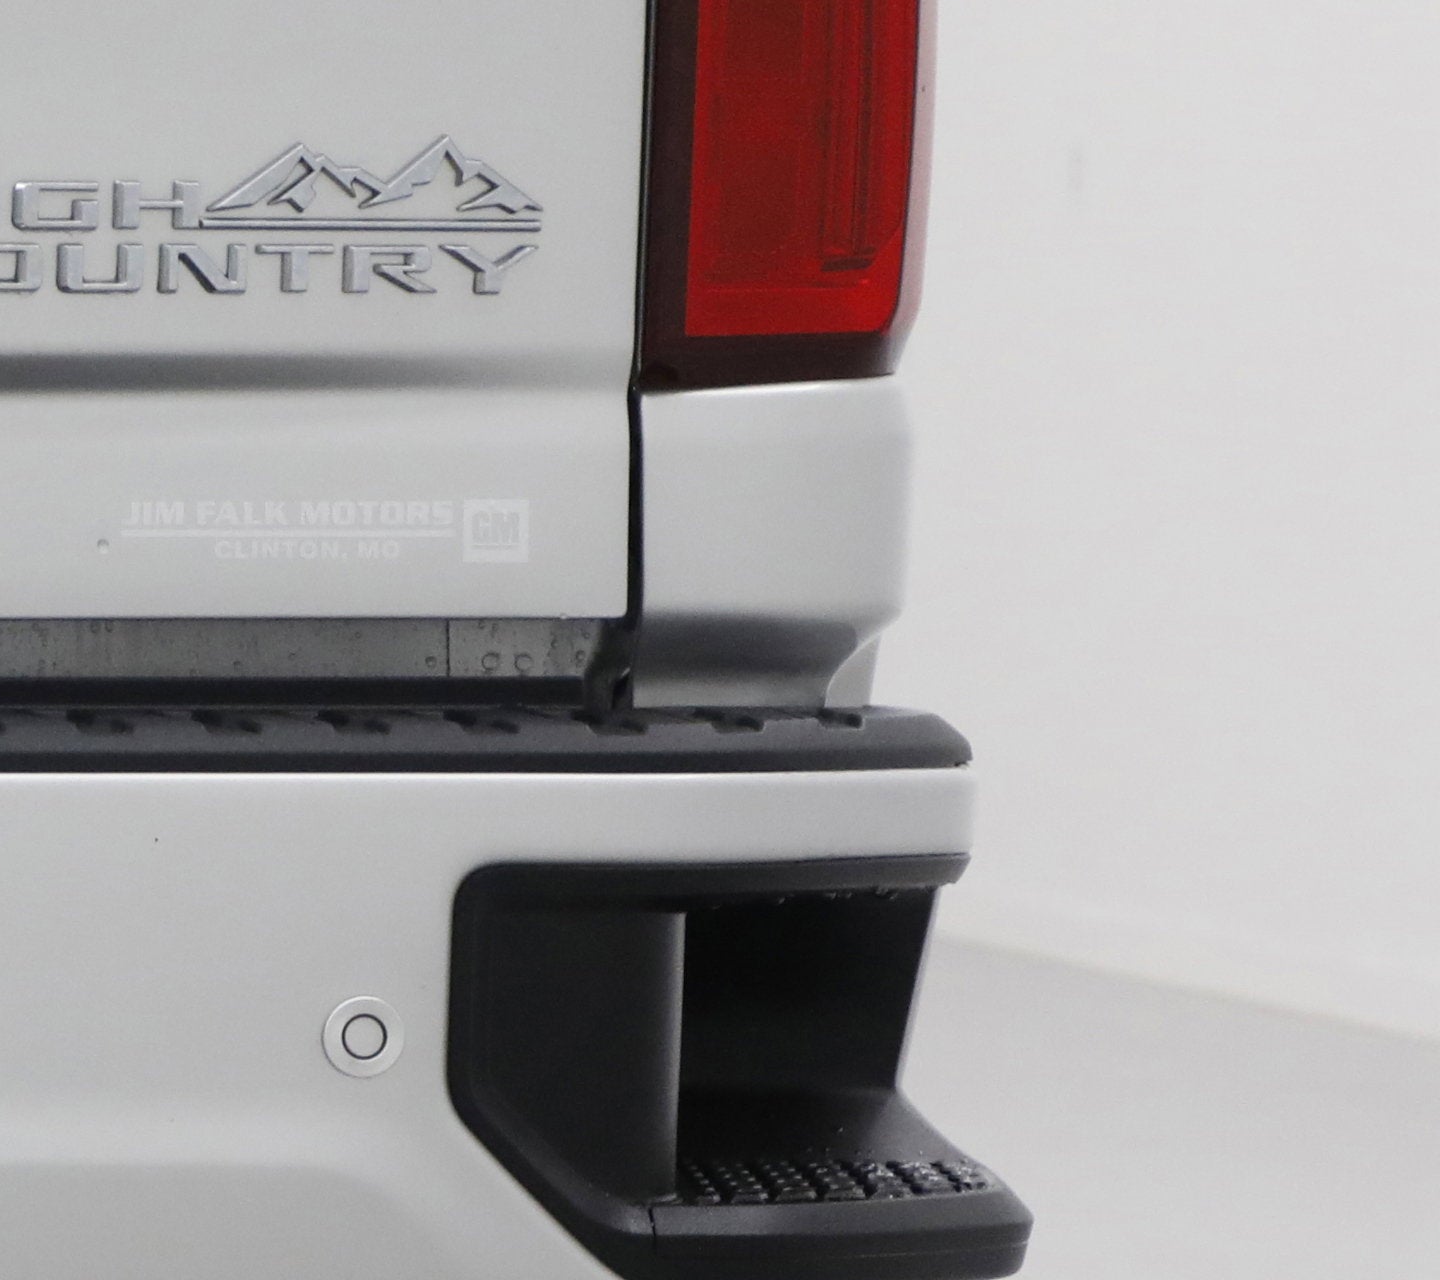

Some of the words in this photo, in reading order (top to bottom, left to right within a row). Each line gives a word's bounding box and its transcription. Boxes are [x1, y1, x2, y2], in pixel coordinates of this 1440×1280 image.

[122, 500, 184, 526] JIM
[200, 500, 291, 526] FALK
[300, 500, 455, 526] MOTORS
[214, 539, 347, 561] CLINTON,
[357, 539, 401, 559] MO
